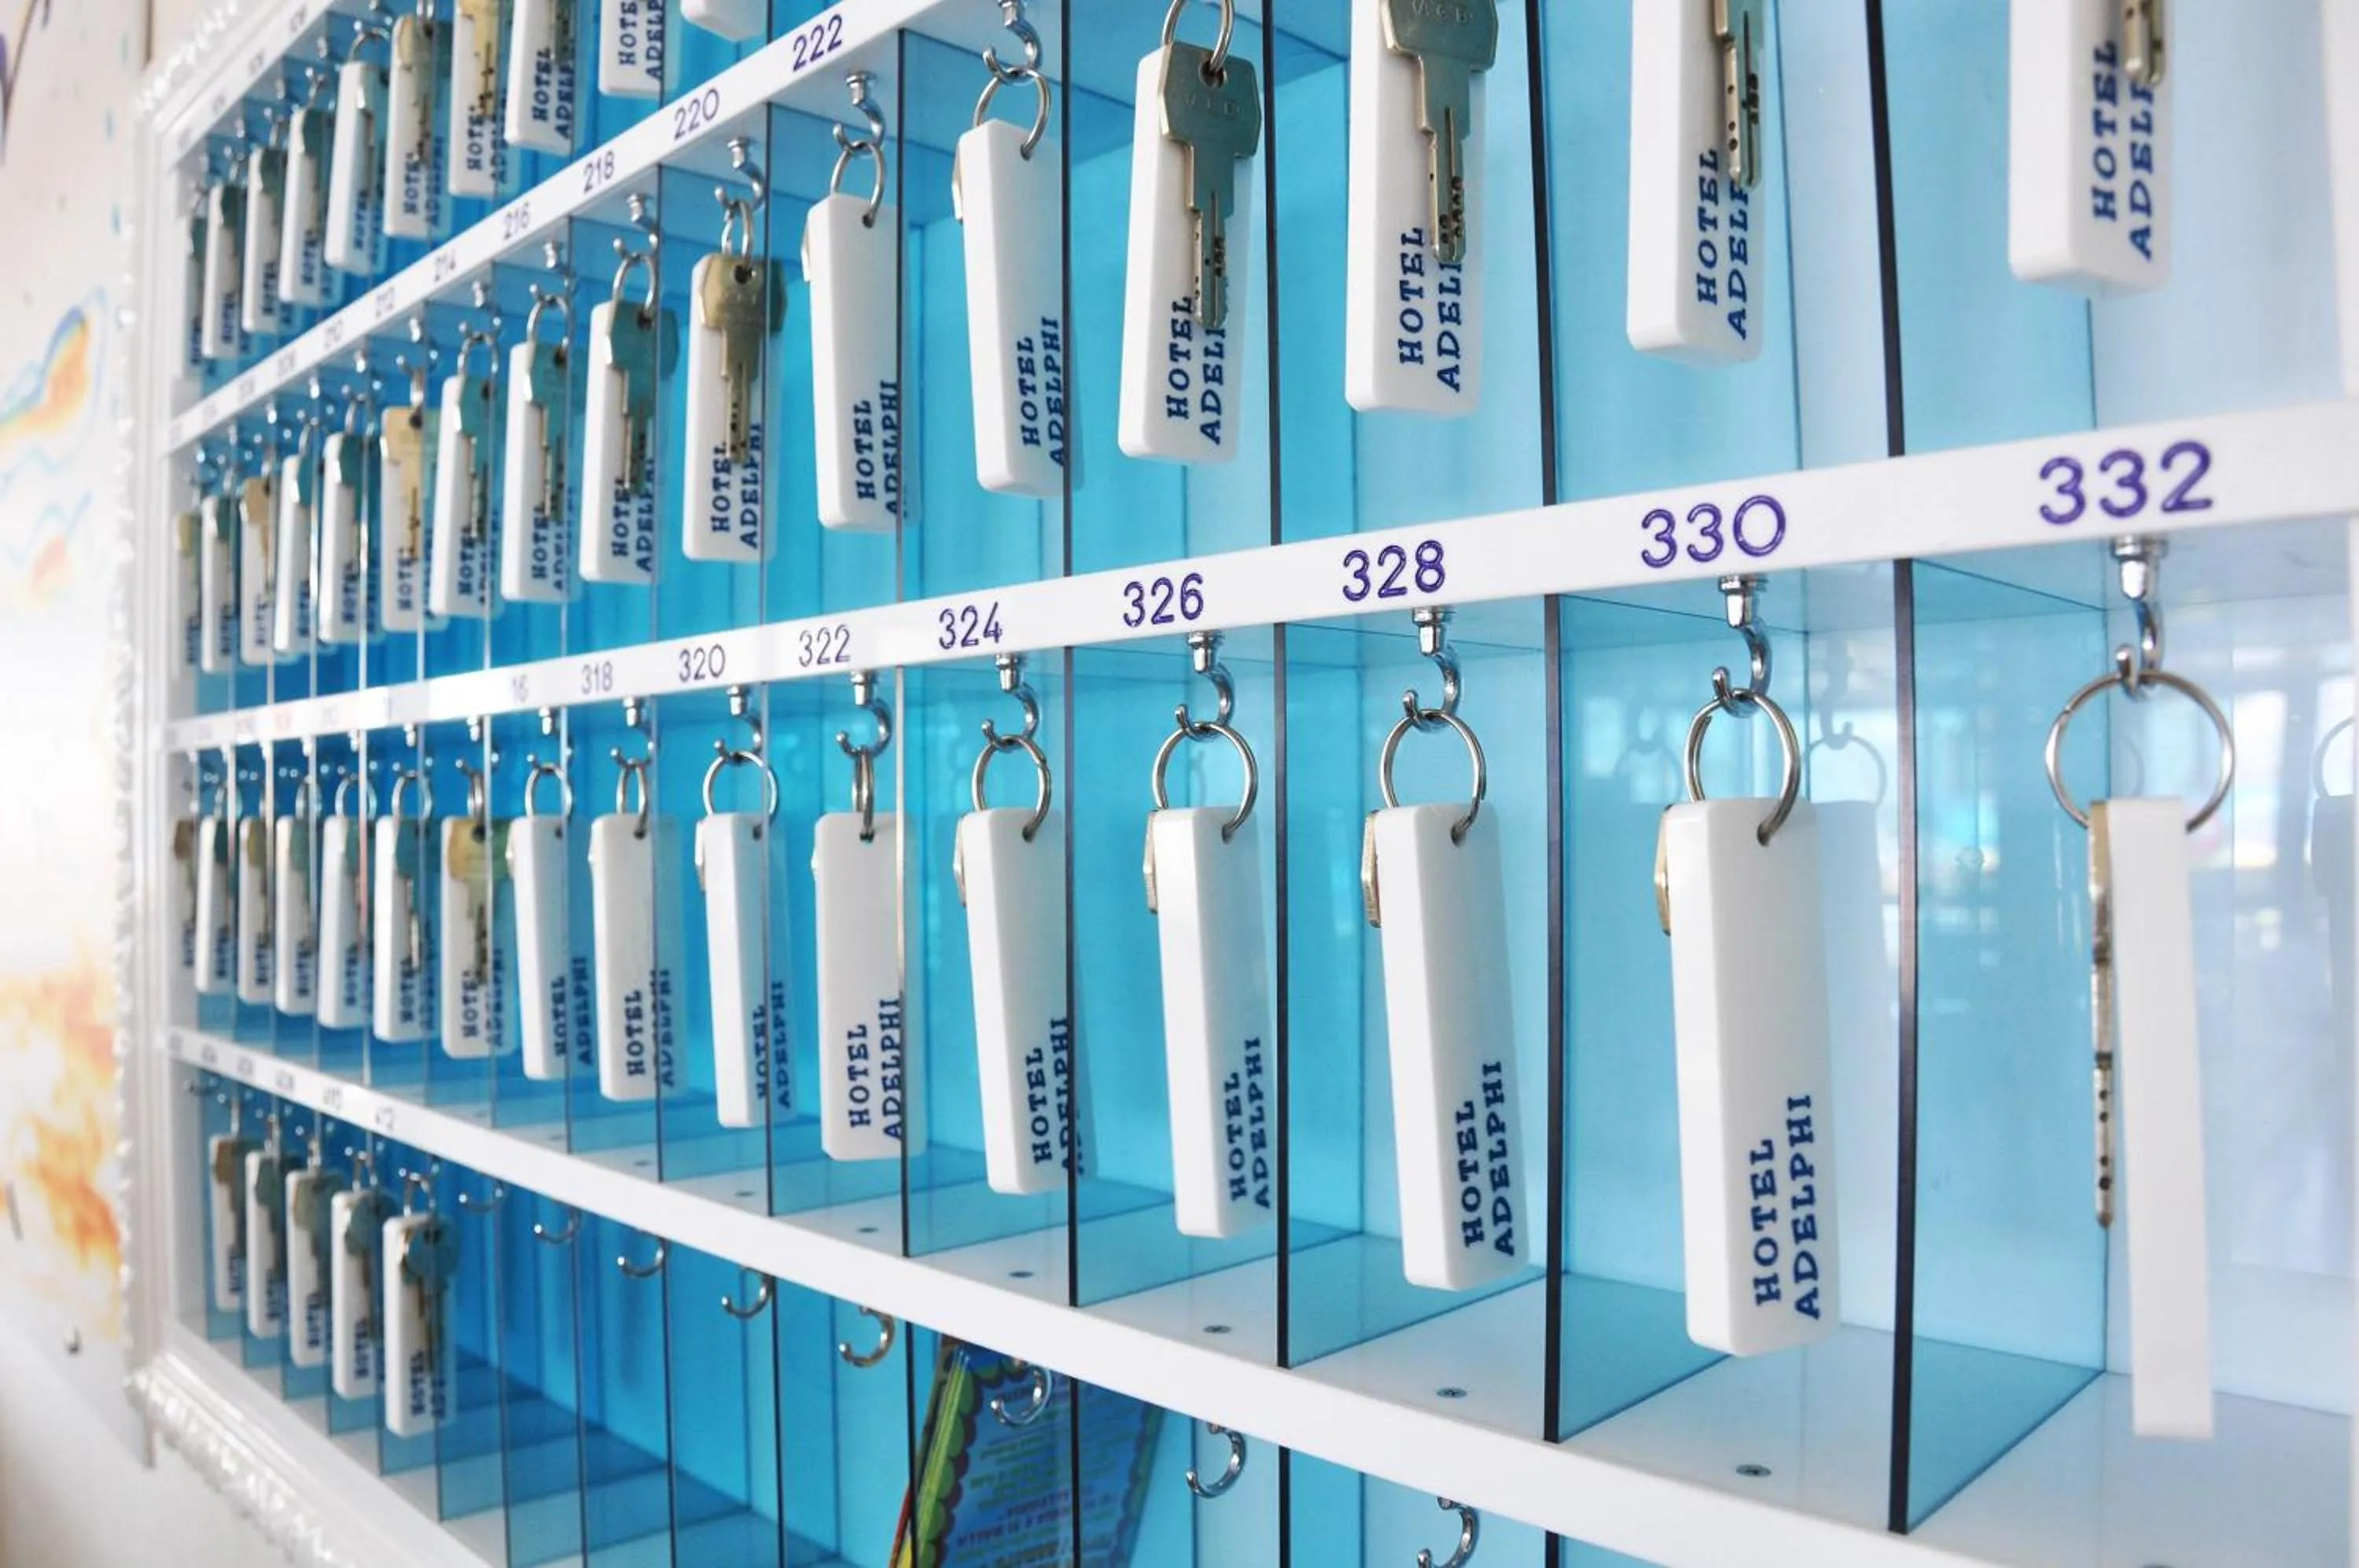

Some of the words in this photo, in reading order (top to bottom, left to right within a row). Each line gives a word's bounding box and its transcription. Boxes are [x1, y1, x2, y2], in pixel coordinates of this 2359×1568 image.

[531, 46, 551, 122] HOTEL
[619, 0, 638, 65] HOTE
[646, 0, 665, 82] ADELP
[793, 14, 843, 72] 222
[674, 89, 719, 141] 220
[2092, 40, 2118, 223] HOTEL
[503, 203, 532, 240] 216
[583, 150, 615, 193] 218
[1696, 148, 1718, 306] HOTEL
[1399, 227, 1426, 366] HOTEL
[1437, 262, 1461, 392] ADEL
[1017, 337, 1041, 447] HOTEL
[1041, 316, 1063, 468] ADELPHI
[1167, 296, 1193, 421] HOTEL
[1199, 328, 1225, 444] ADEL
[853, 399, 877, 500] HOTEL
[879, 380, 899, 517] ADELPHI
[2038, 440, 2214, 525] 332
[1341, 539, 1447, 604] 328
[1640, 494, 1787, 569] 330
[798, 624, 851, 668] 322
[938, 602, 1003, 650] 324
[1122, 572, 1205, 628] 326
[581, 661, 613, 694] 318
[679, 645, 727, 683] 320
[550, 976, 567, 1058] HOTEL
[572, 955, 594, 1066] ADELPHI
[624, 989, 645, 1077] HOTEL
[753, 1004, 767, 1099] HOTEL
[771, 981, 792, 1110] ADELPHI
[846, 1024, 872, 1128] HOTEL
[878, 999, 903, 1141] ADELPHI
[1025, 1047, 1053, 1165] HOTEL
[1224, 1073, 1247, 1202] HOTEL
[1244, 1036, 1271, 1210] ADELPHI
[1456, 1100, 1485, 1249] HOTEL
[1482, 1061, 1515, 1257] ADELPHI
[1750, 1139, 1782, 1306] HOTEL
[1786, 1095, 1821, 1321] ADELPHI
